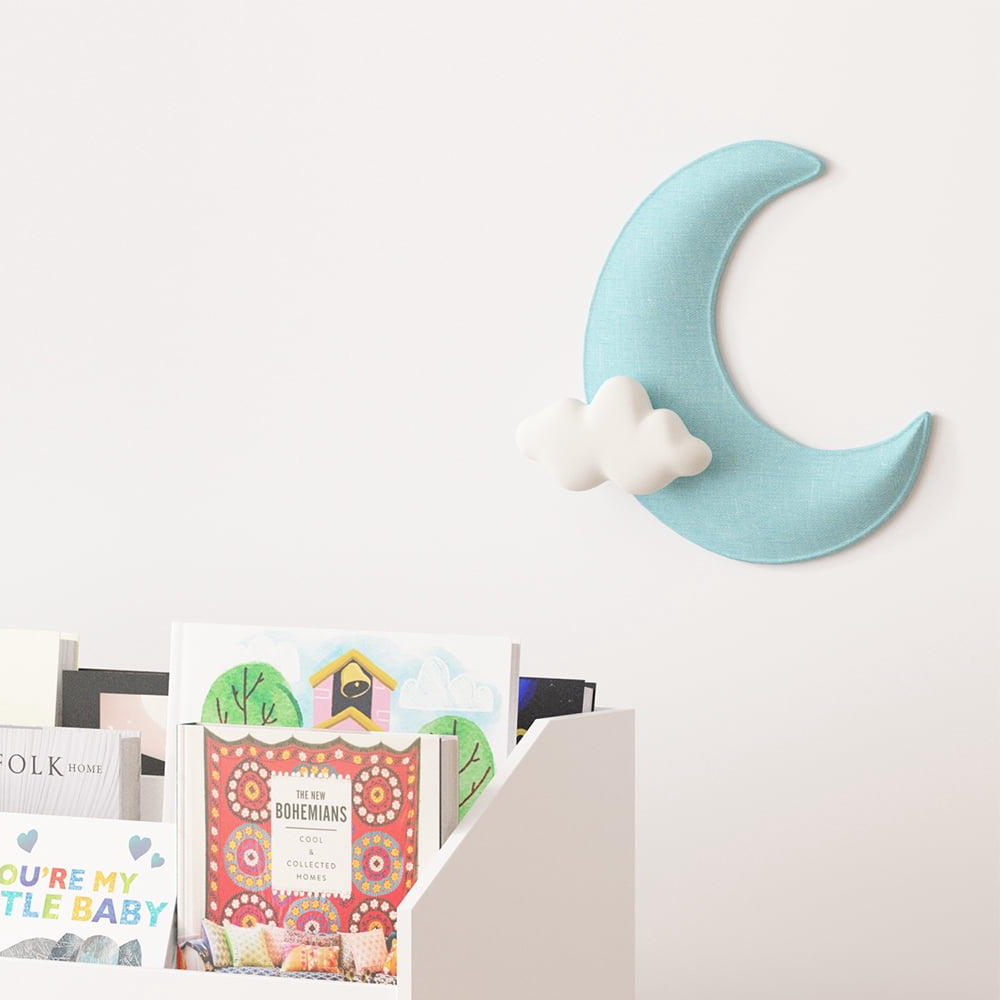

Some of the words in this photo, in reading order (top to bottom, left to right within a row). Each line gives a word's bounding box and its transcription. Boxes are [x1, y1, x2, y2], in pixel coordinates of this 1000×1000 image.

[68, 763, 103, 774] HOME
[296, 789, 308, 800] THE
[311, 790, 326, 800] NEW
[275, 802, 347, 823] BOHEMIANS
[299, 835, 323, 844] COOL
[286, 860, 336, 870] COLLECTED
[92, 870, 139, 894] MY
[296, 873, 327, 882] HOMES
[71, 895, 169, 928] BABY
